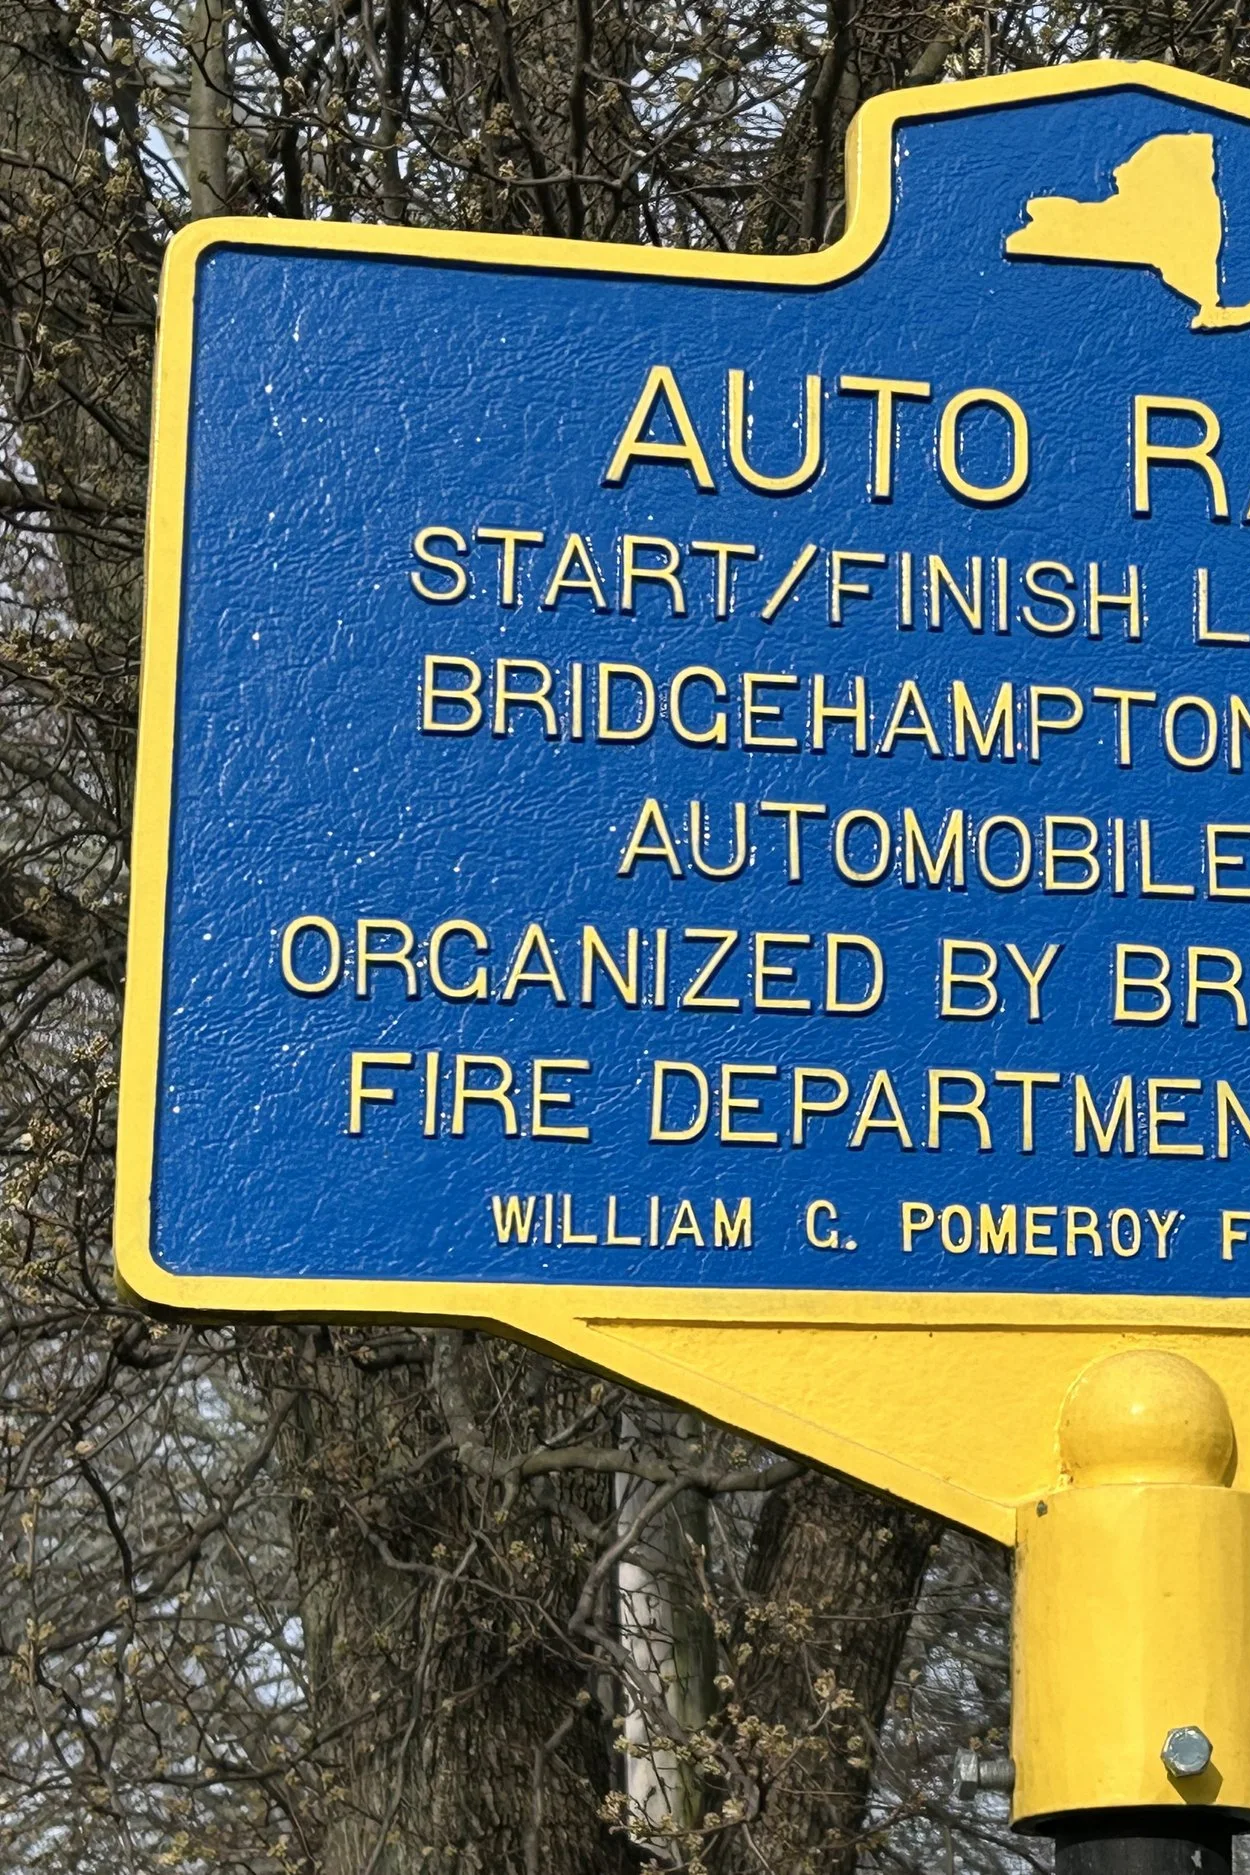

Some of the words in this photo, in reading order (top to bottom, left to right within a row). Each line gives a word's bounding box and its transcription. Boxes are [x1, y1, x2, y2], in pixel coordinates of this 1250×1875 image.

[605, 364, 1029, 502] AUTO
[410, 526, 1140, 637] START/FINISH
[281, 914, 884, 1012] ORGANIZED
[941, 938, 1059, 1019] BY
[349, 1051, 590, 1139] FIRE
[492, 1194, 752, 1248] WILLIAM
[806, 1199, 857, 1251] G.
[901, 1201, 1178, 1259] POMEROY
